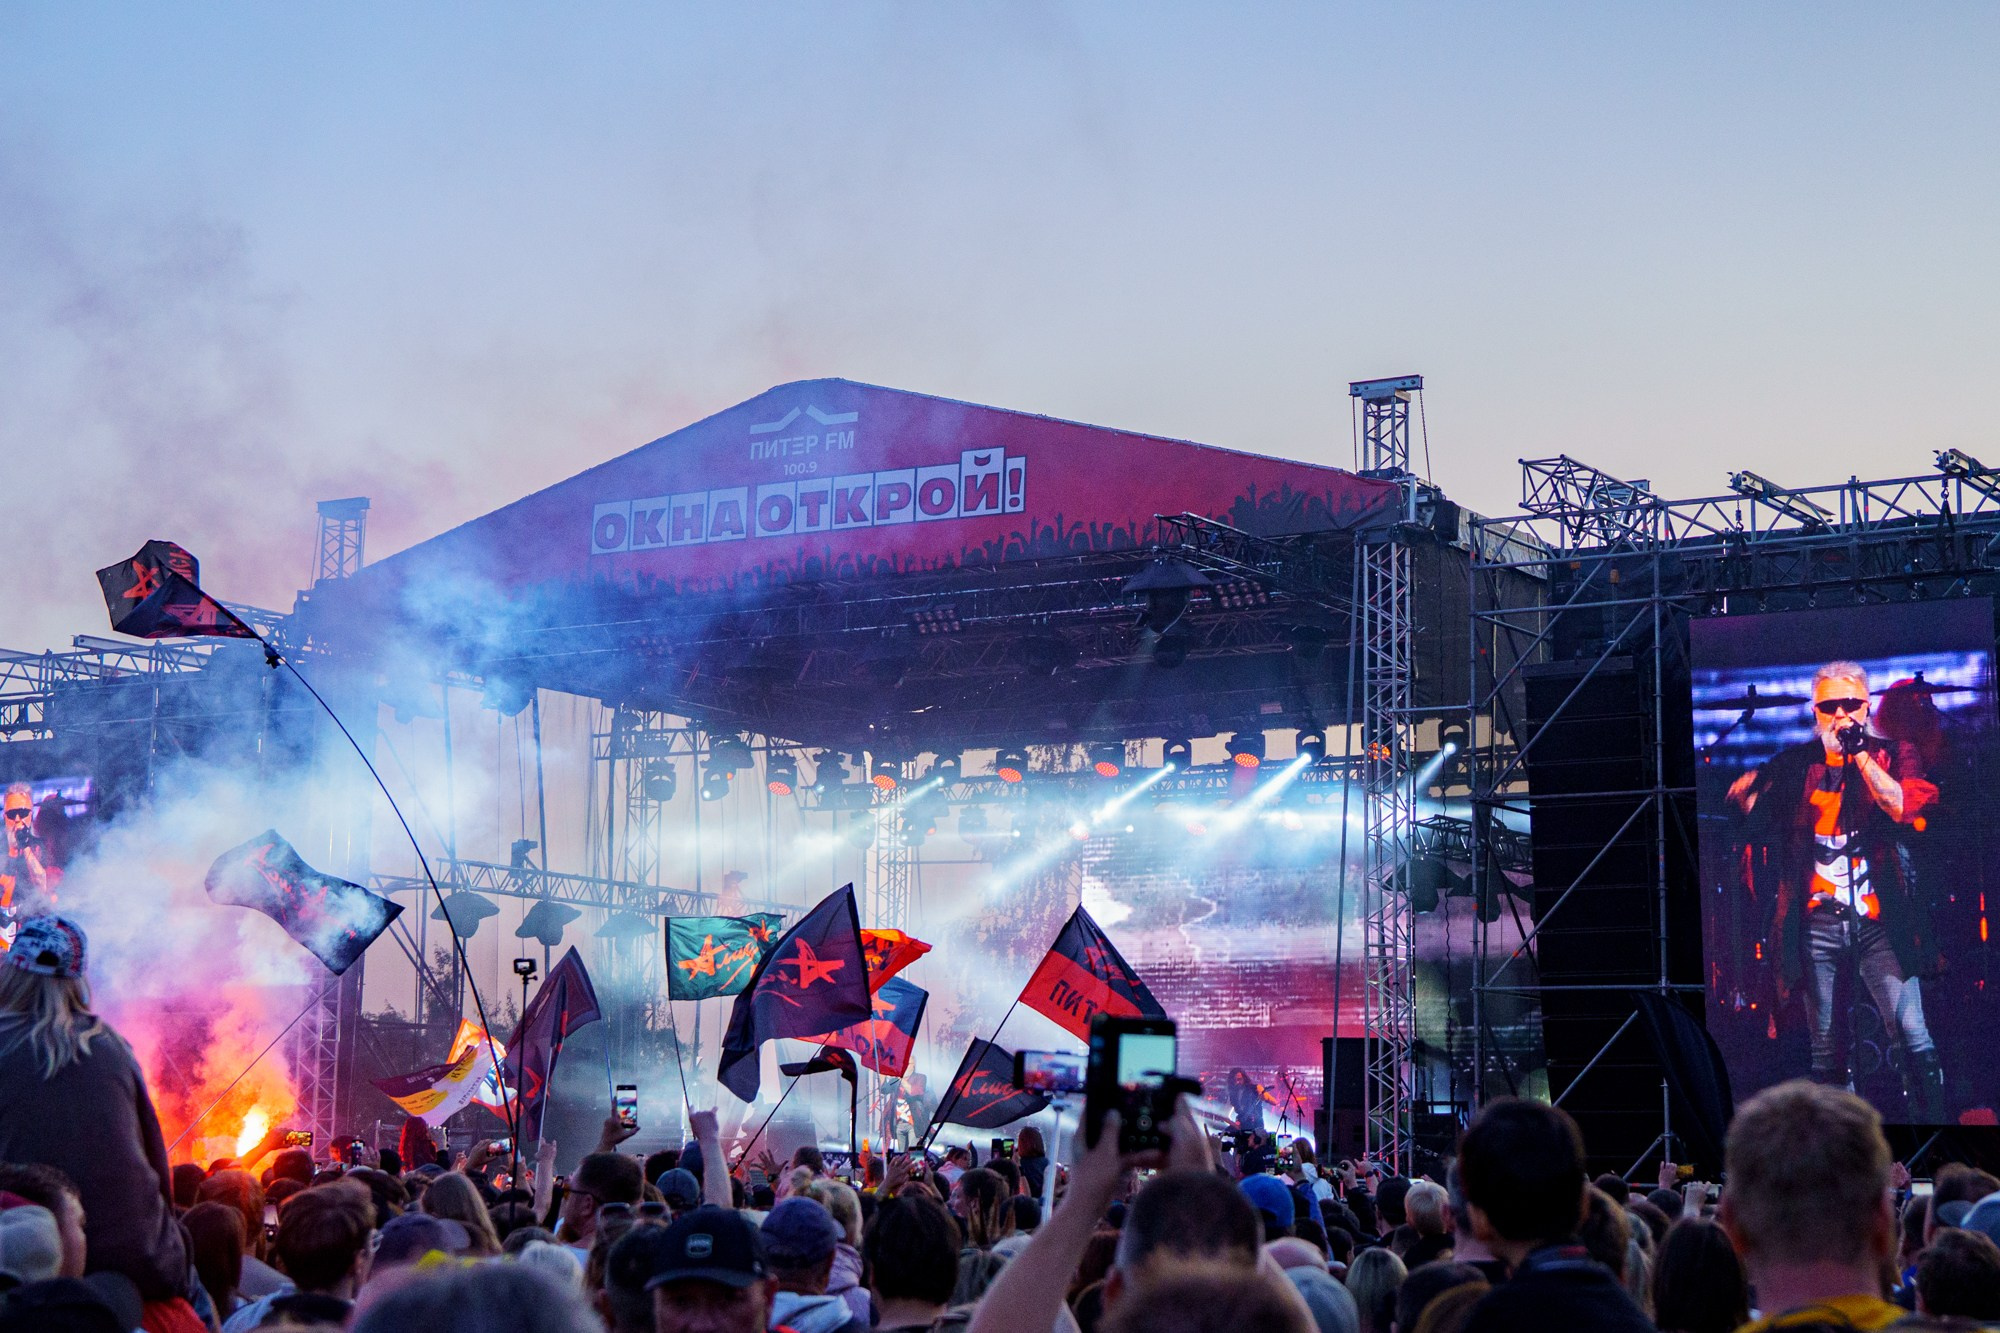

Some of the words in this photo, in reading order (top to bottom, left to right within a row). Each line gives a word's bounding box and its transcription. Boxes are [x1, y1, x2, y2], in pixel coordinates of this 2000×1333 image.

[750, 435, 819, 460] ПИТЕР
[826, 430, 855, 451] FM
[783, 461, 818, 476] 100.9
[593, 499, 746, 550] ОКНА
[757, 453, 1023, 533] ОТКРОЙ!
[1049, 979, 1099, 1025] ПИТ
